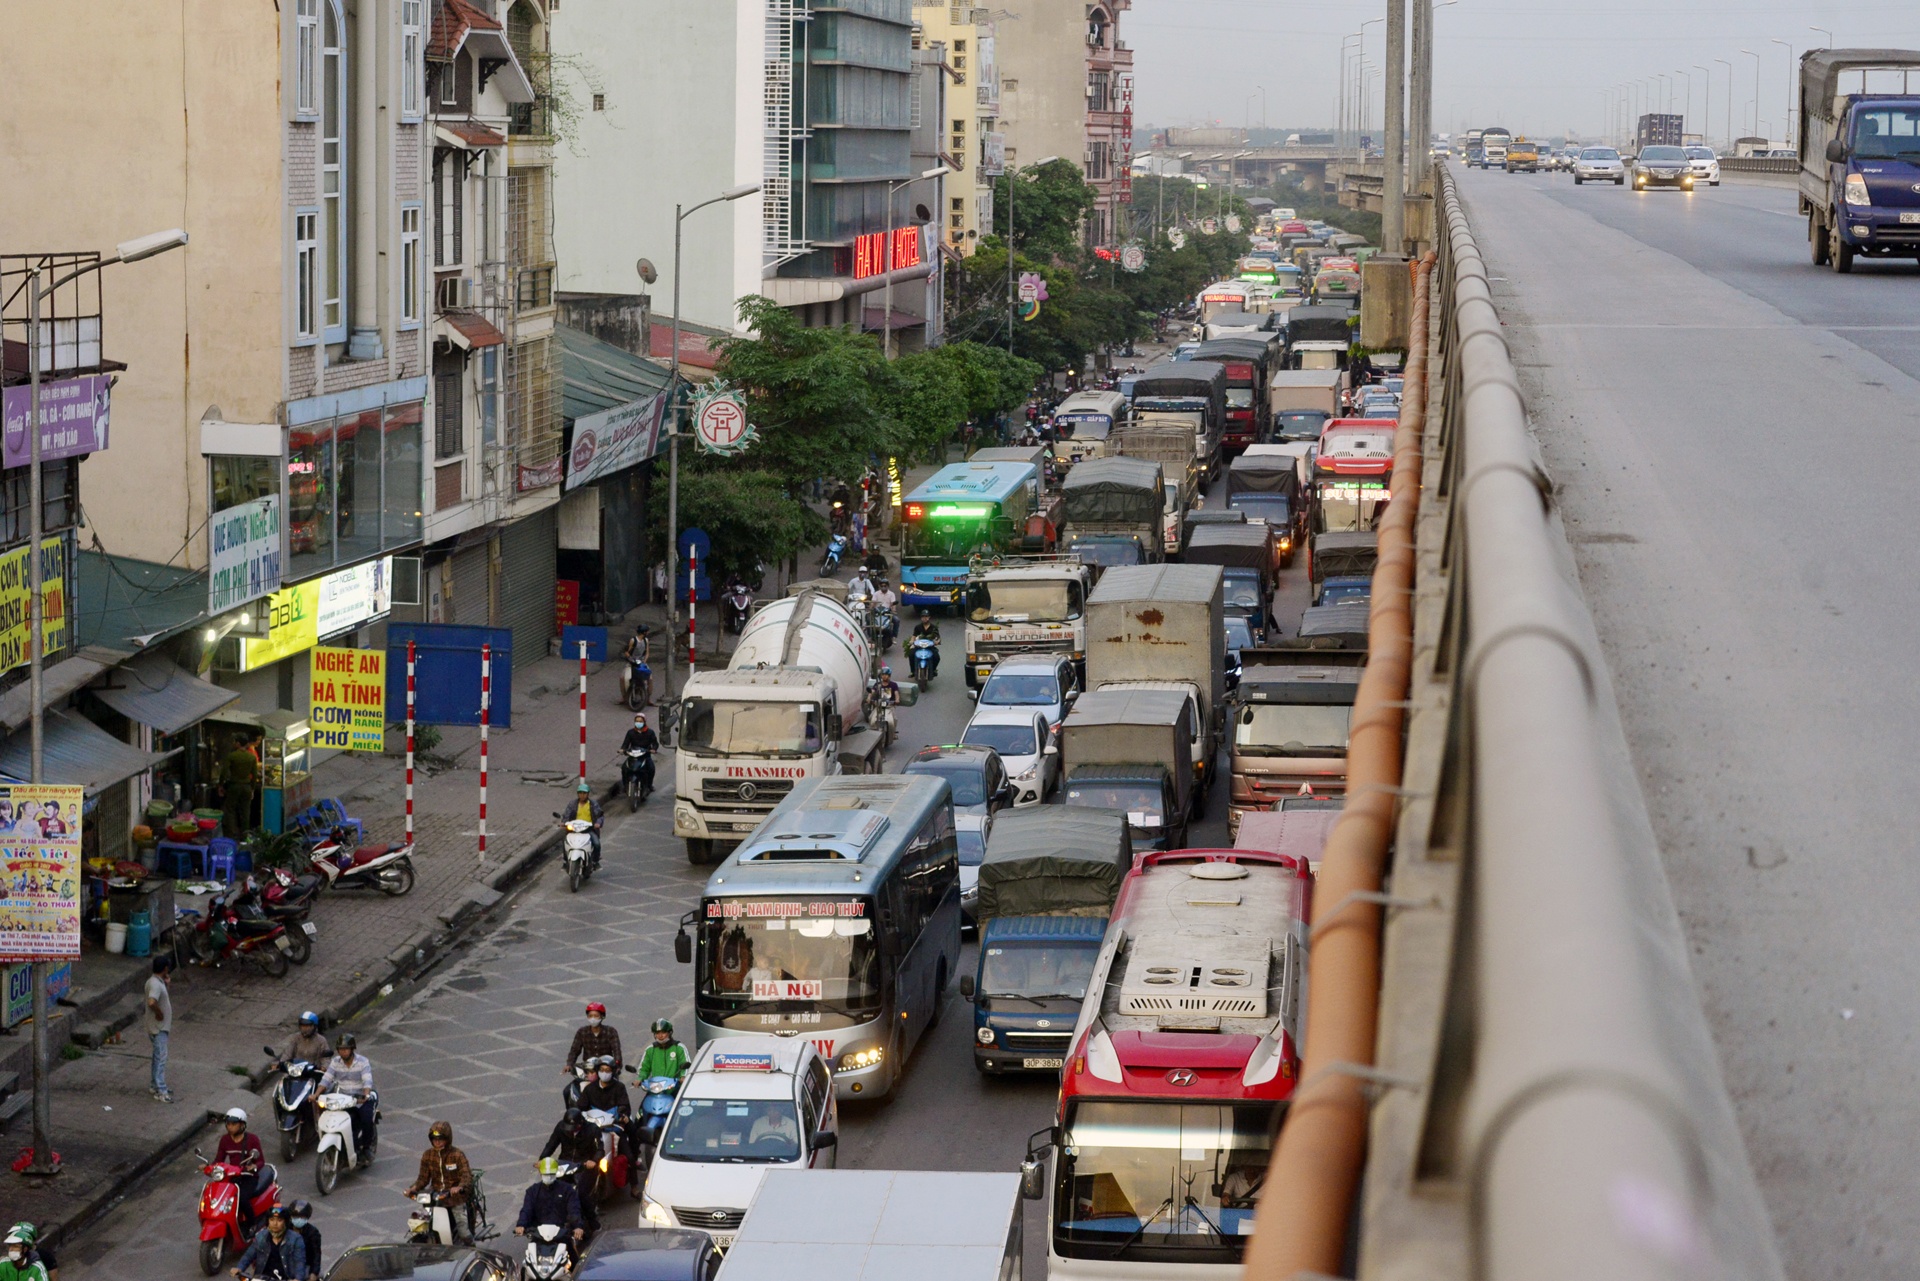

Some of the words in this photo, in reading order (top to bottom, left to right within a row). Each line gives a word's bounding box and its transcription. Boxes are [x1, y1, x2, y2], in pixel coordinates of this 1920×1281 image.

[896, 226, 920, 269] HOTEL
[77, 402, 92, 418] RANG
[1, 558, 19, 592] CƠM
[213, 567, 230, 610] CƠM
[250, 549, 261, 596] HÀ
[1, 631, 20, 670] DÂN
[316, 650, 354, 677] NGHỆ
[359, 655, 379, 674] AN
[314, 678, 336, 702] HÀ
[342, 680, 381, 705] TĨNH
[313, 706, 351, 724] CƠM
[355, 709, 382, 718] NÓNG
[355, 718, 382, 728] RANG
[314, 726, 349, 746] PHỞ
[726, 767, 805, 778] TRANSMECO
[708, 900, 721, 917] HÀ
[774, 902, 801, 919] ĐỊNH
[809, 902, 835, 916] GIAO
[837, 898, 865, 916] THỦY
[754, 982, 779, 996] HÀ
[787, 981, 820, 998] NỘI
